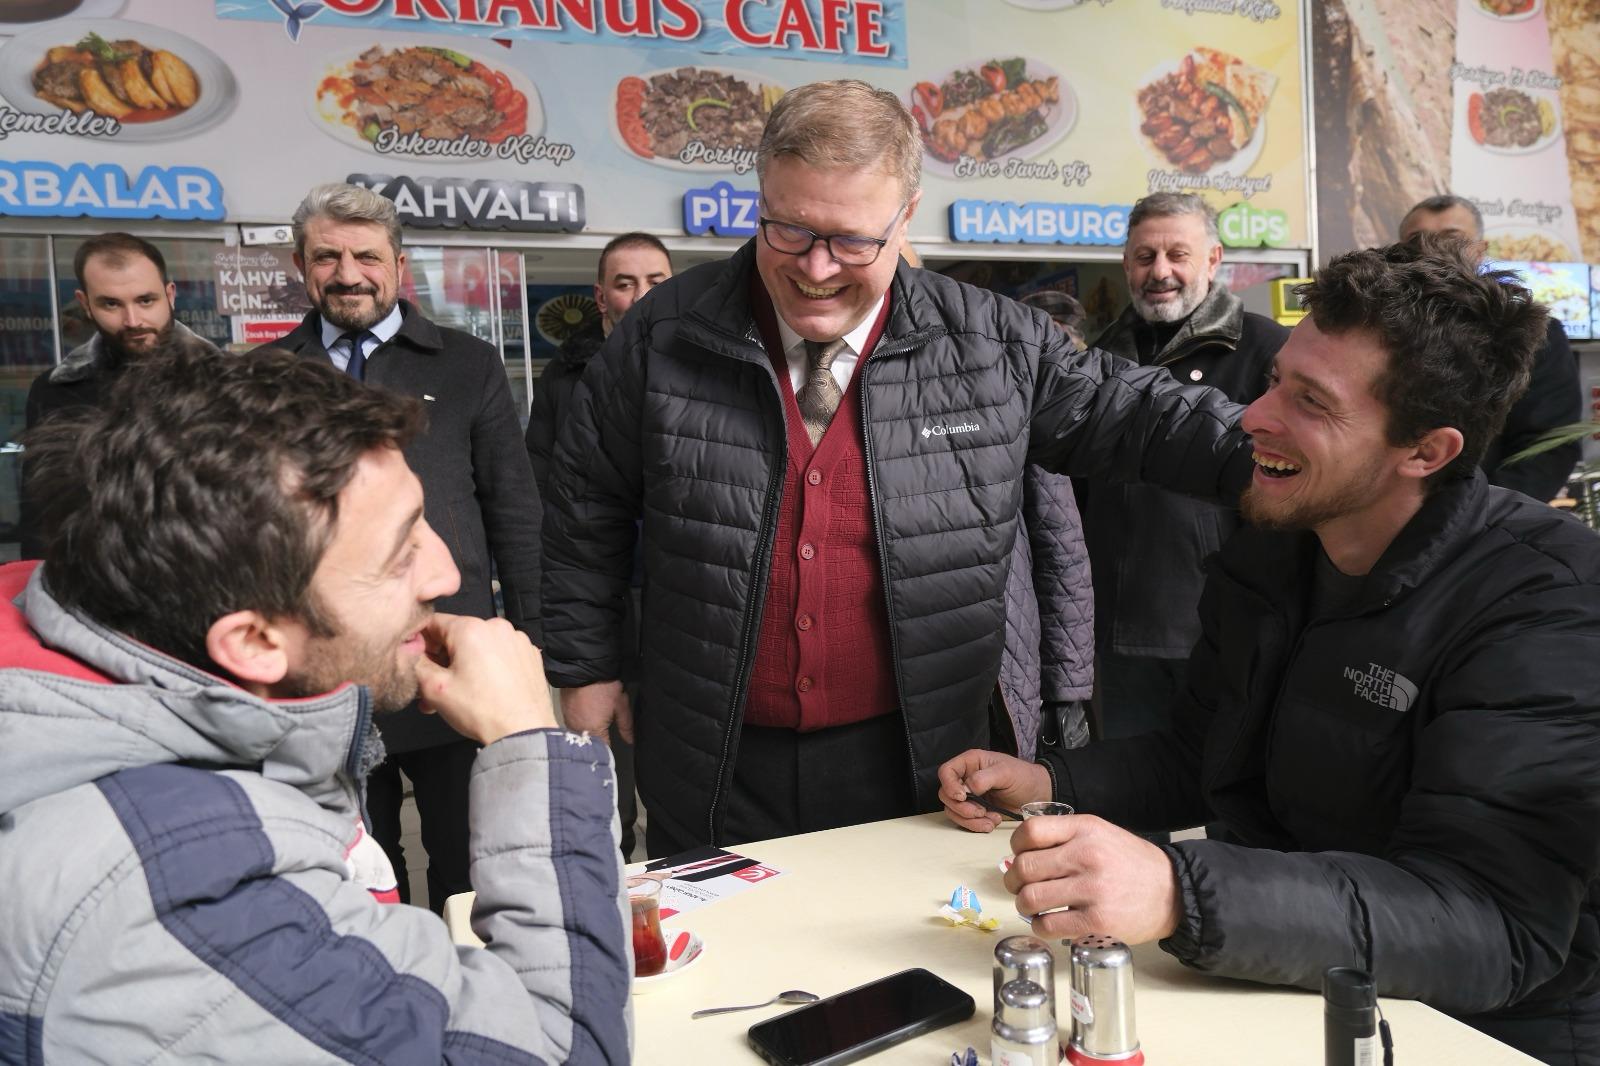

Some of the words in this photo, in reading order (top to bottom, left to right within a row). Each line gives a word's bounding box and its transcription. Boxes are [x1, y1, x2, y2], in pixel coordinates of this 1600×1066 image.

[724, 0, 889, 56] CAFE
[374, 125, 493, 154] İskender
[496, 134, 576, 165] Kebap
[954, 154, 978, 178] Et
[979, 161, 1001, 178] ve
[1004, 157, 1059, 181] Tavuk
[691, 188, 760, 230] PİZ
[959, 205, 1126, 239] HAMBURG
[1223, 208, 1284, 241] CİPS
[220, 271, 287, 286] KAHVE
[932, 422, 980, 436] Columbia
[1343, 666, 1392, 696] NORTH
[1368, 662, 1395, 684] THE
[1353, 683, 1390, 708] FACE
